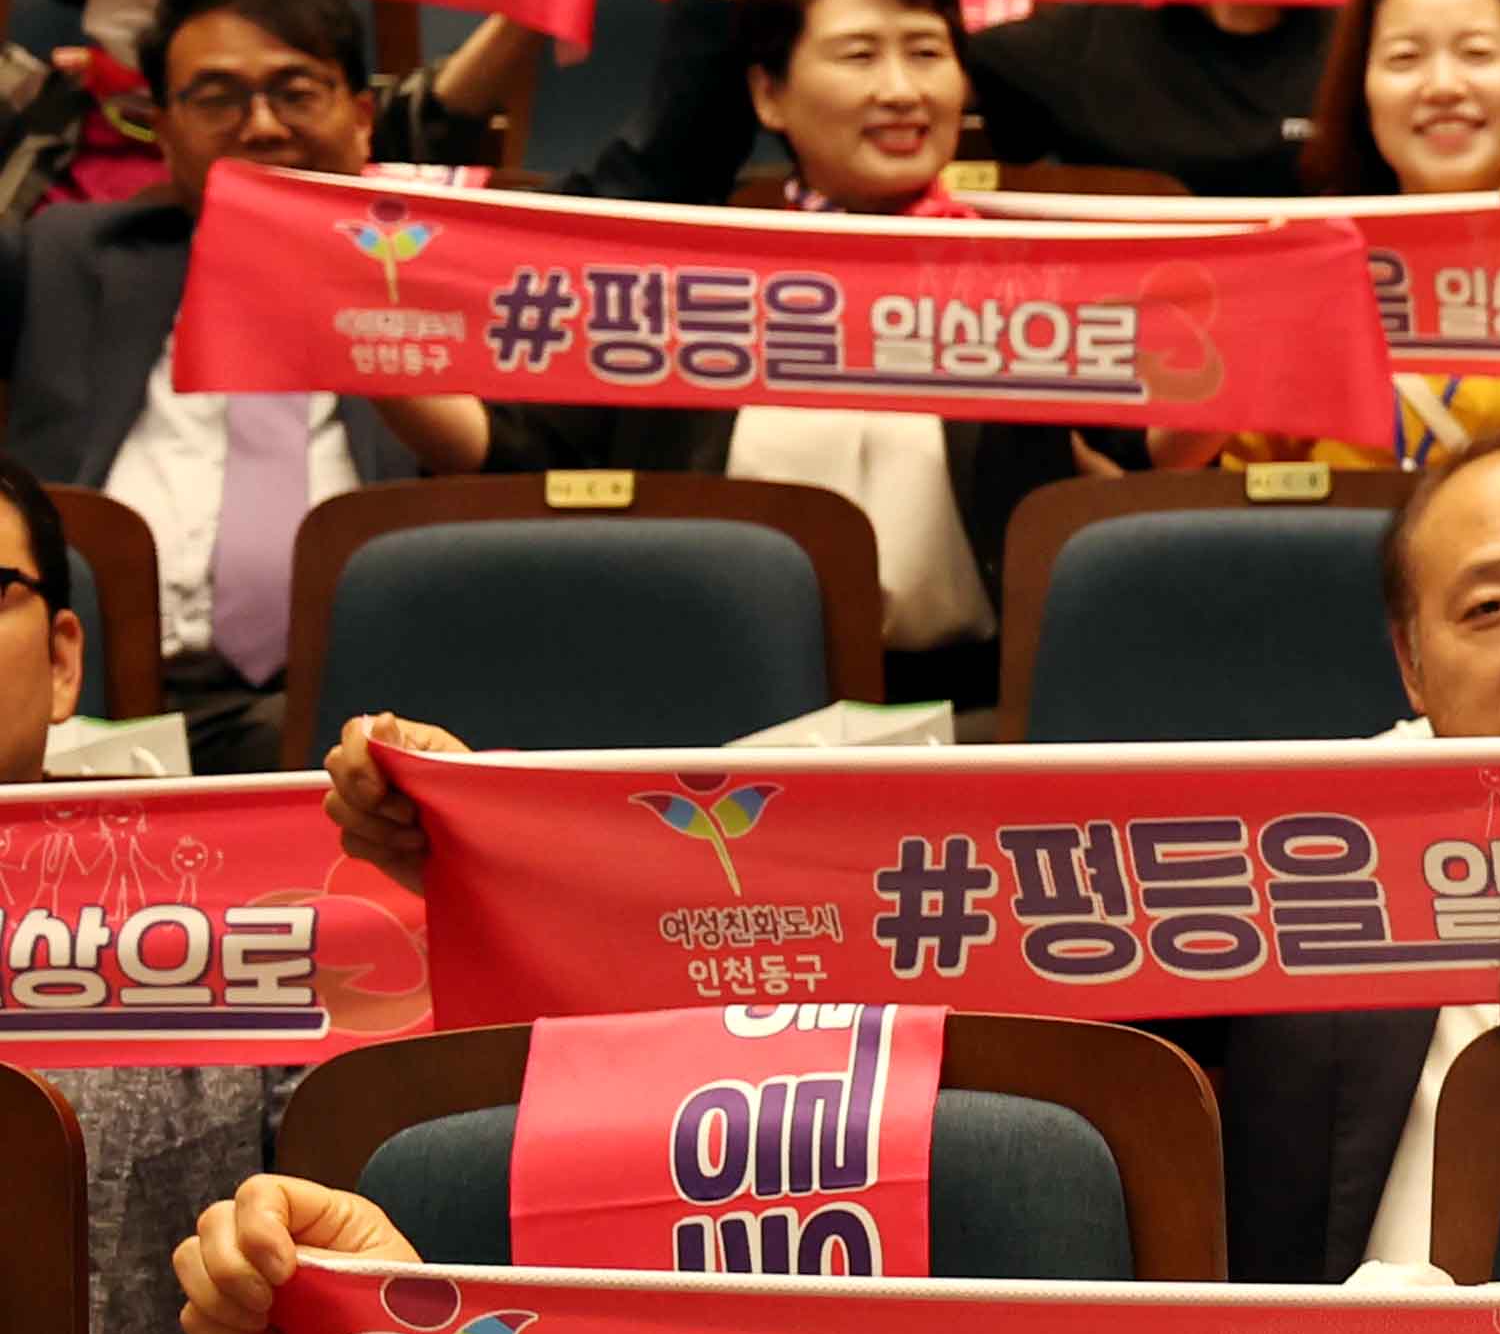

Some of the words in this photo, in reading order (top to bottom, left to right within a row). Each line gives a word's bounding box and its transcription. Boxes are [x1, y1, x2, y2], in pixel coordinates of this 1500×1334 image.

[486, 266, 845, 390] #평등을
[869, 295, 1140, 380] 일상으로
[659, 902, 844, 945] 여성친화도시
[871, 811, 1393, 986] #평등을
[688, 954, 828, 997] 인천동구
